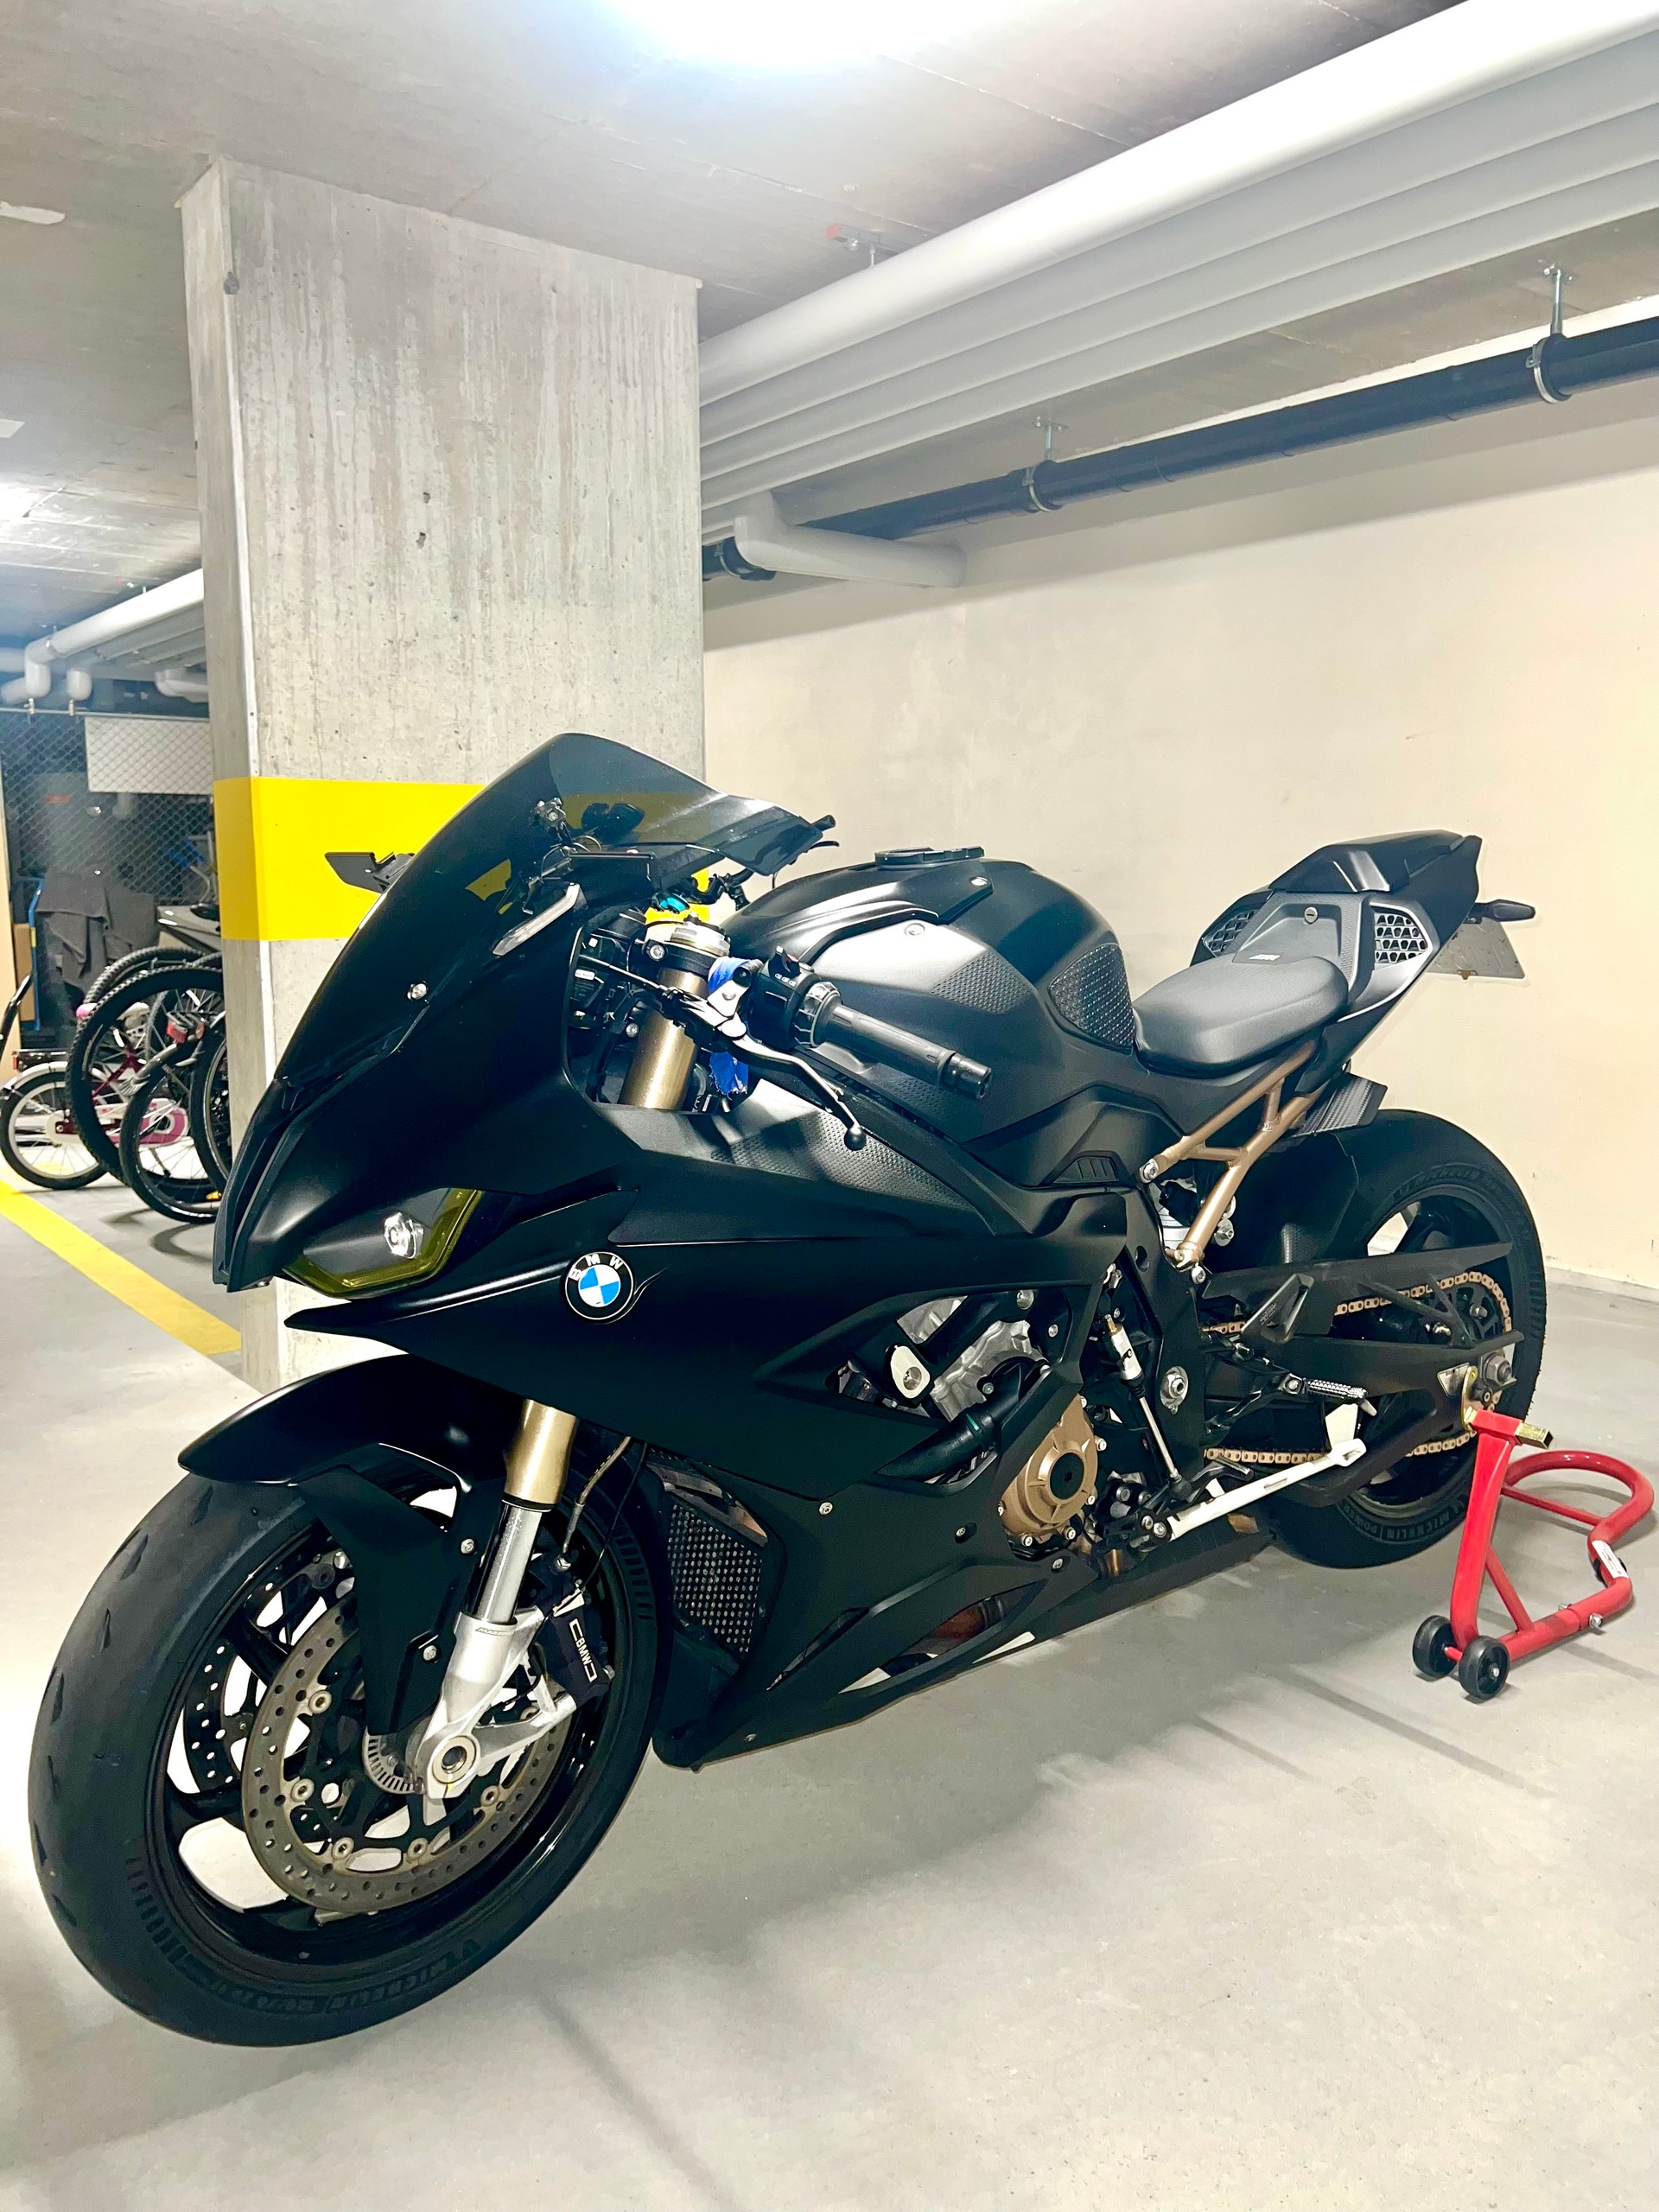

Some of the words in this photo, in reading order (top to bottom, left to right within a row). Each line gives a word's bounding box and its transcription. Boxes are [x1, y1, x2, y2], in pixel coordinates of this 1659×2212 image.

[569, 1253, 624, 1281] BMW
[1387, 1511, 1450, 1540] MICHELIN
[575, 1637, 593, 1665] BMW
